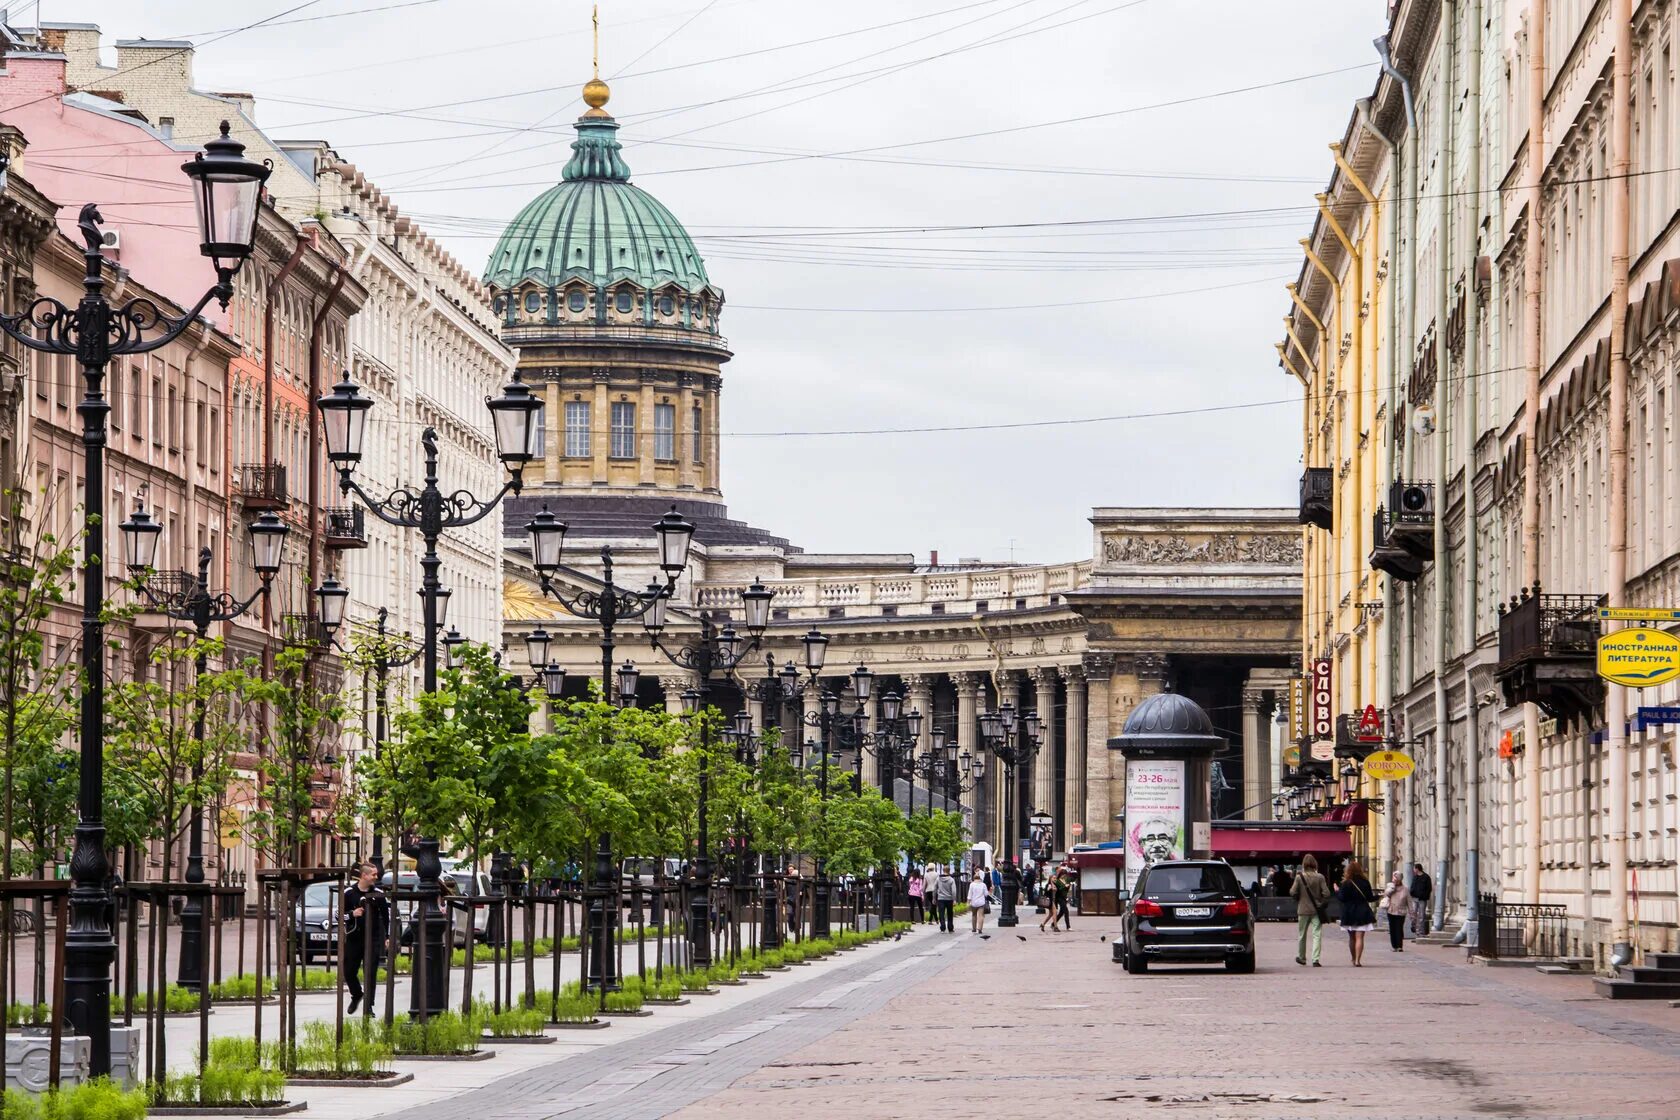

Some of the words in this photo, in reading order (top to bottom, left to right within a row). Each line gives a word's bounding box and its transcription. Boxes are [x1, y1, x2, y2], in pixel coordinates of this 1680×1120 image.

[1602, 644, 1678, 652] ИНОСТРАННАЯ
[1607, 655, 1672, 663] ЛИТЕРАТУРА
[1316, 662, 1330, 734] СЛОВО
[1294, 680, 1303, 739] КЛИНИКА
[1642, 711, 1660, 719] PAUL
[1367, 761, 1411, 770] KORONA
[1138, 774, 1163, 783] 23-26
